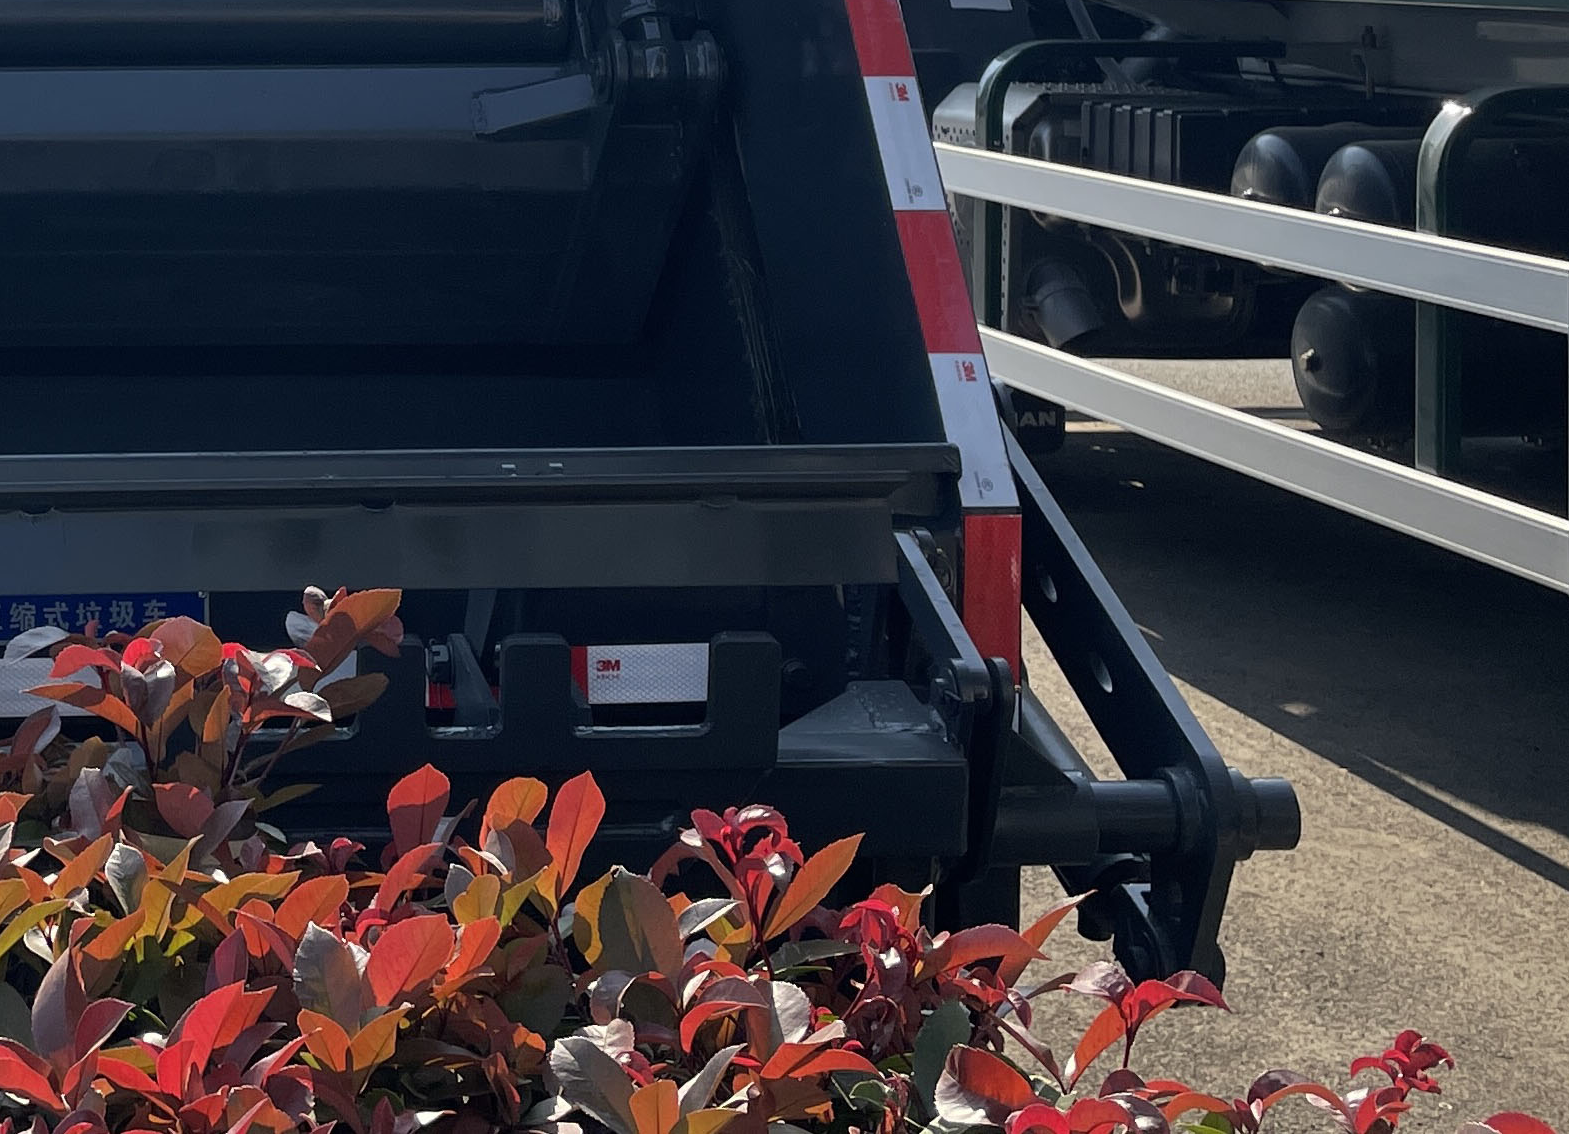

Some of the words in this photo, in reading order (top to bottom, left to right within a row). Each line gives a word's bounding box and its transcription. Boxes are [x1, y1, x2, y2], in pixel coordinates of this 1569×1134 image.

[895, 82, 911, 102] 3M
[962, 361, 977, 382] 3M
[1015, 411, 1056, 427] AN
[596, 659, 621, 672] 3M
